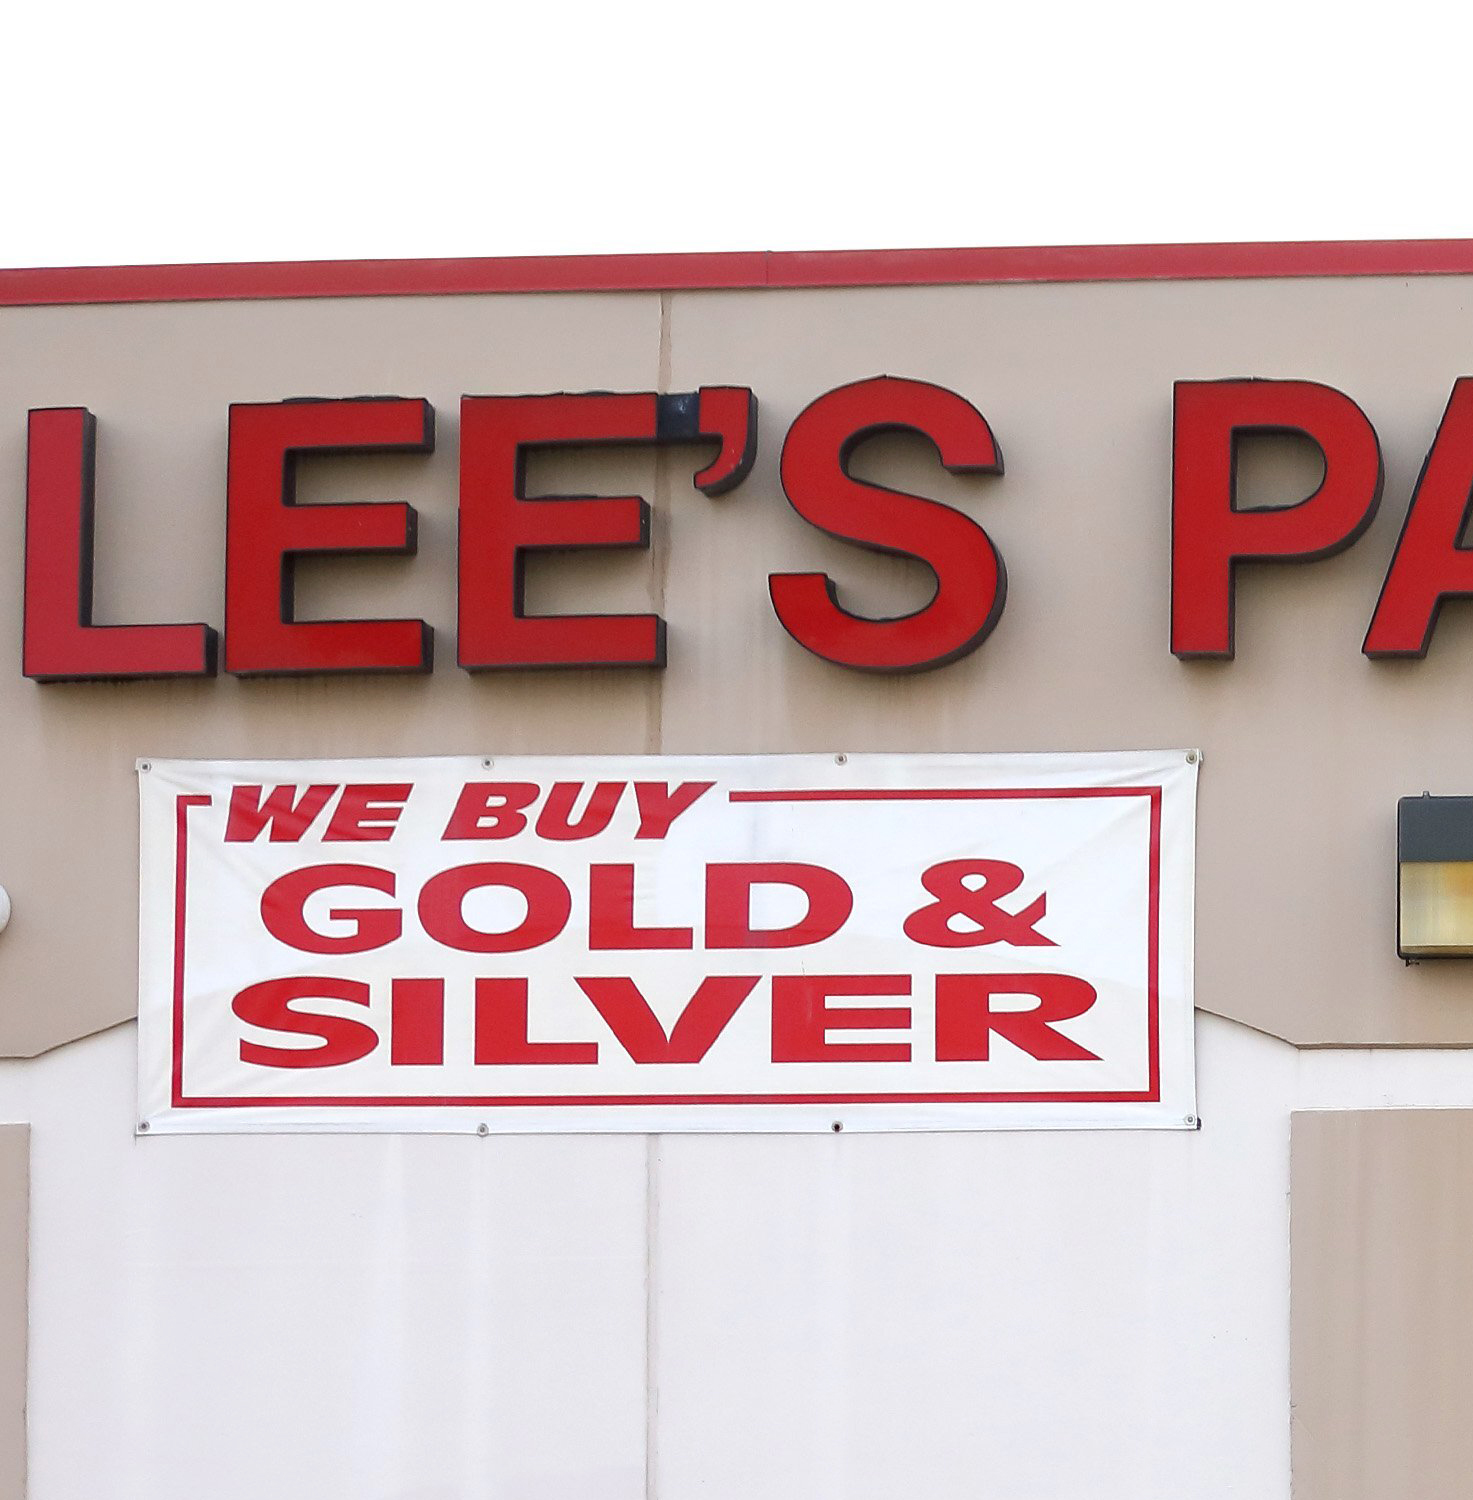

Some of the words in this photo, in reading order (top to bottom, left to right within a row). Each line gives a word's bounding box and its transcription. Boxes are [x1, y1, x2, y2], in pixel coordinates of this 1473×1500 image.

[22, 375, 1007, 682] LEE'S
[225, 784, 412, 843] WE
[442, 782, 714, 841] BUY
[260, 863, 853, 954] GOLD
[904, 858, 1058, 948] &
[231, 974, 1101, 1068] SILVER
